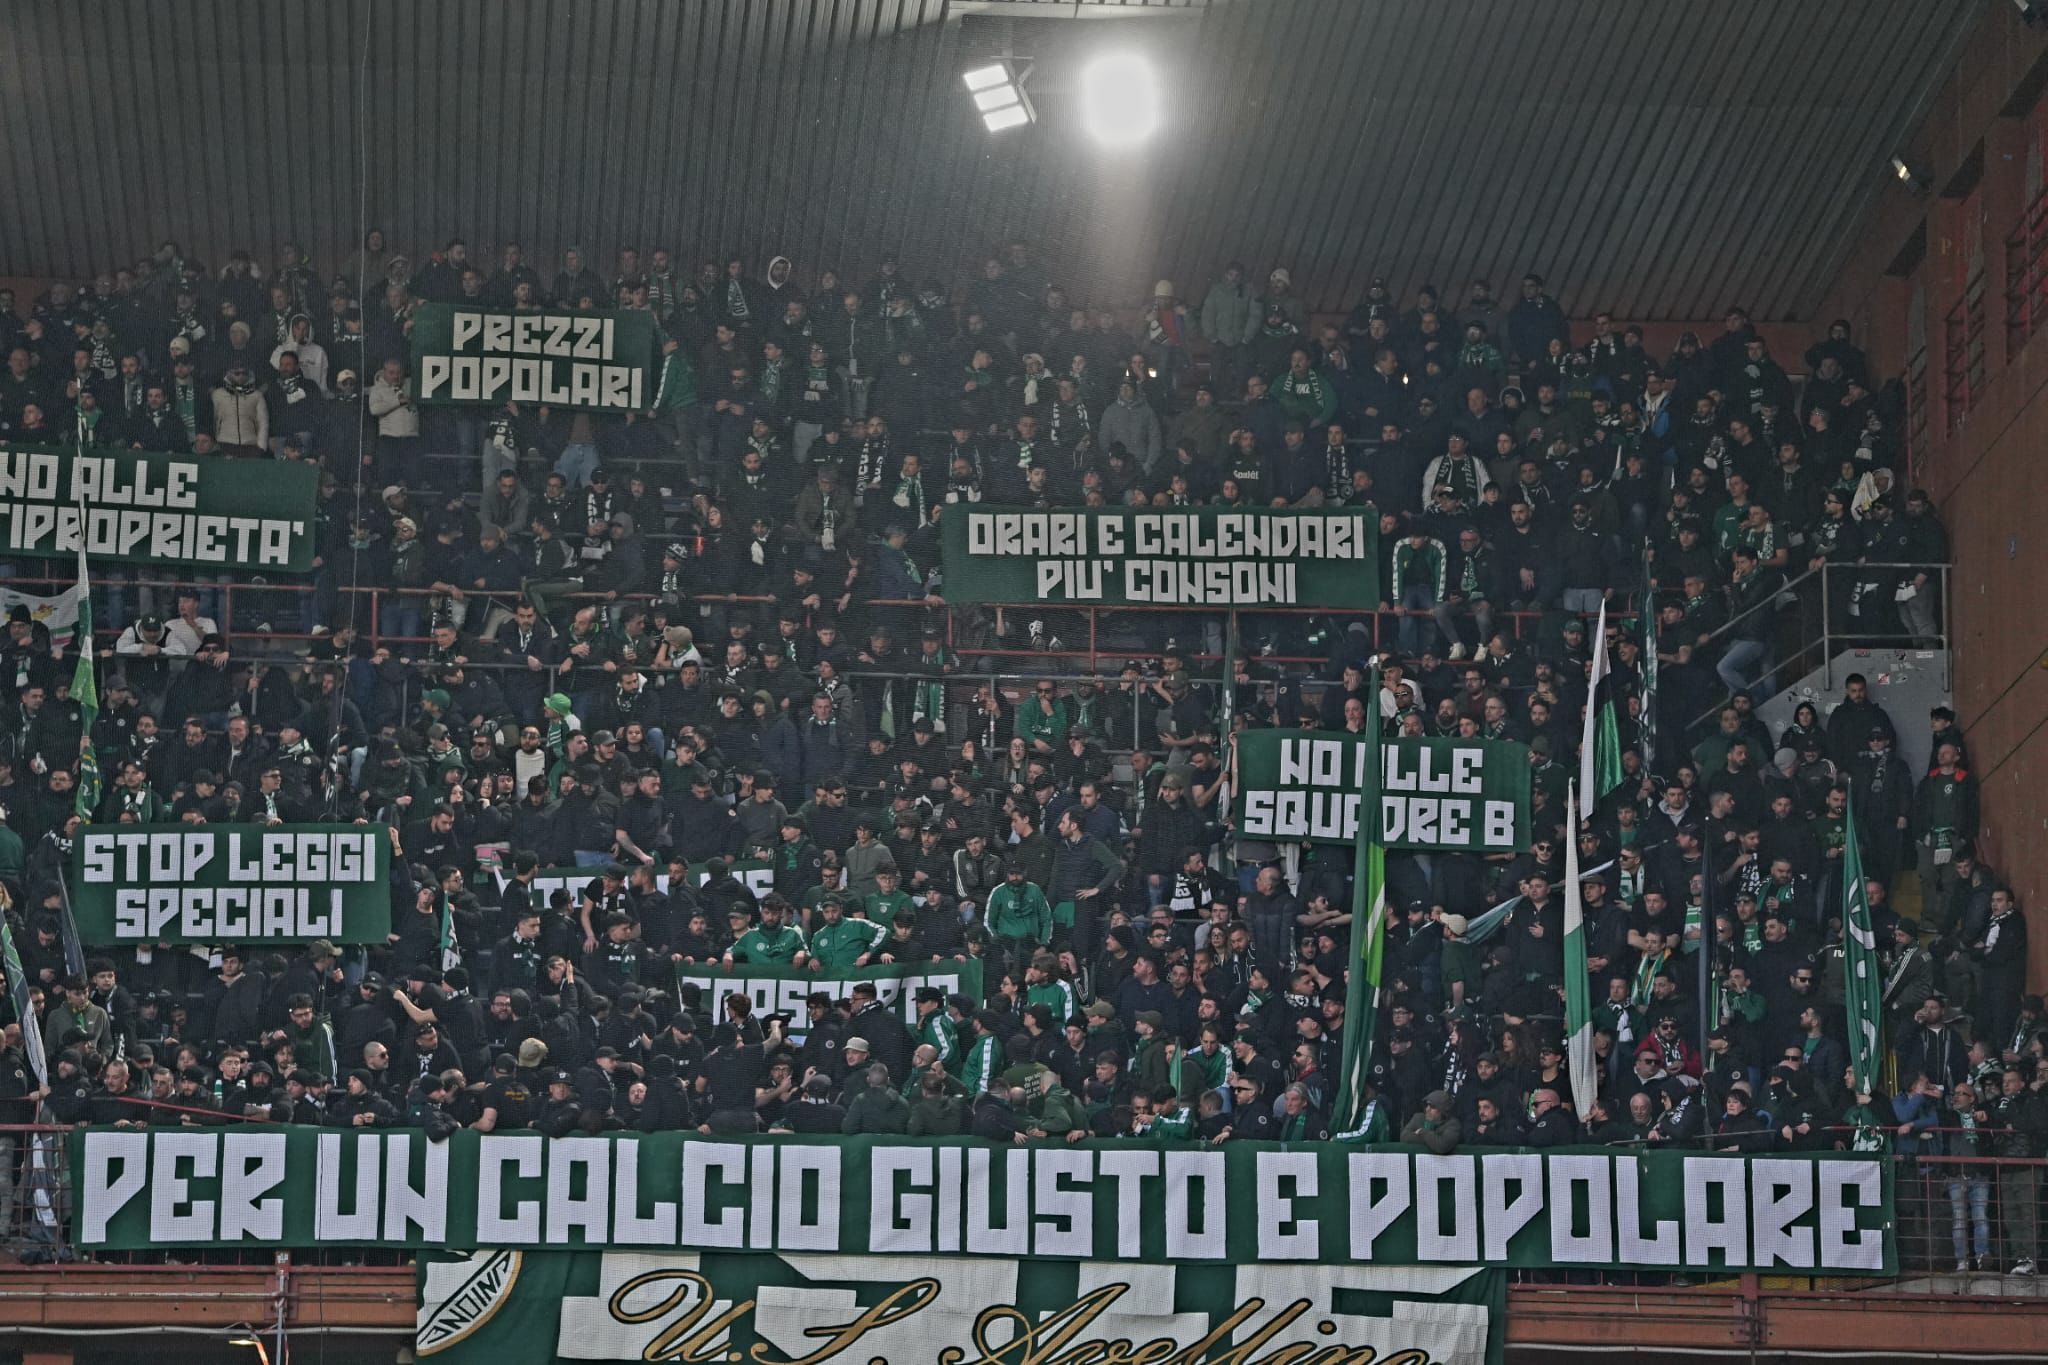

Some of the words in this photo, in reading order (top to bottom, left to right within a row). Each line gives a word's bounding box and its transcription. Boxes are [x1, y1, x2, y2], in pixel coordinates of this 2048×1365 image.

[453, 312, 614, 360] PREZZI
[421, 355, 642, 409] POPOLARI
[0, 451, 59, 500] NO
[70, 456, 199, 509] ALLE
[0, 503, 304, 565] IPROPRIETA'
[968, 513, 1087, 555] ORARI
[1098, 515, 1124, 555] E
[1135, 514, 1365, 559] CALENDARI
[1037, 560, 1114, 599] PIU'
[1124, 560, 1297, 603] CONSONI
[1280, 738, 1342, 787] NO
[1484, 800, 1515, 846] B
[84, 833, 215, 882] STOP
[229, 833, 376, 882] LEGGI
[115, 888, 343, 938] SPECIALI
[81, 1132, 287, 1243] PER
[315, 1134, 450, 1242] UN
[476, 1136, 841, 1251] CALCIO
[869, 1145, 1226, 1259] GIUSTO
[1256, 1151, 1319, 1260] E
[1348, 1153, 1884, 1270] POPOLARE
